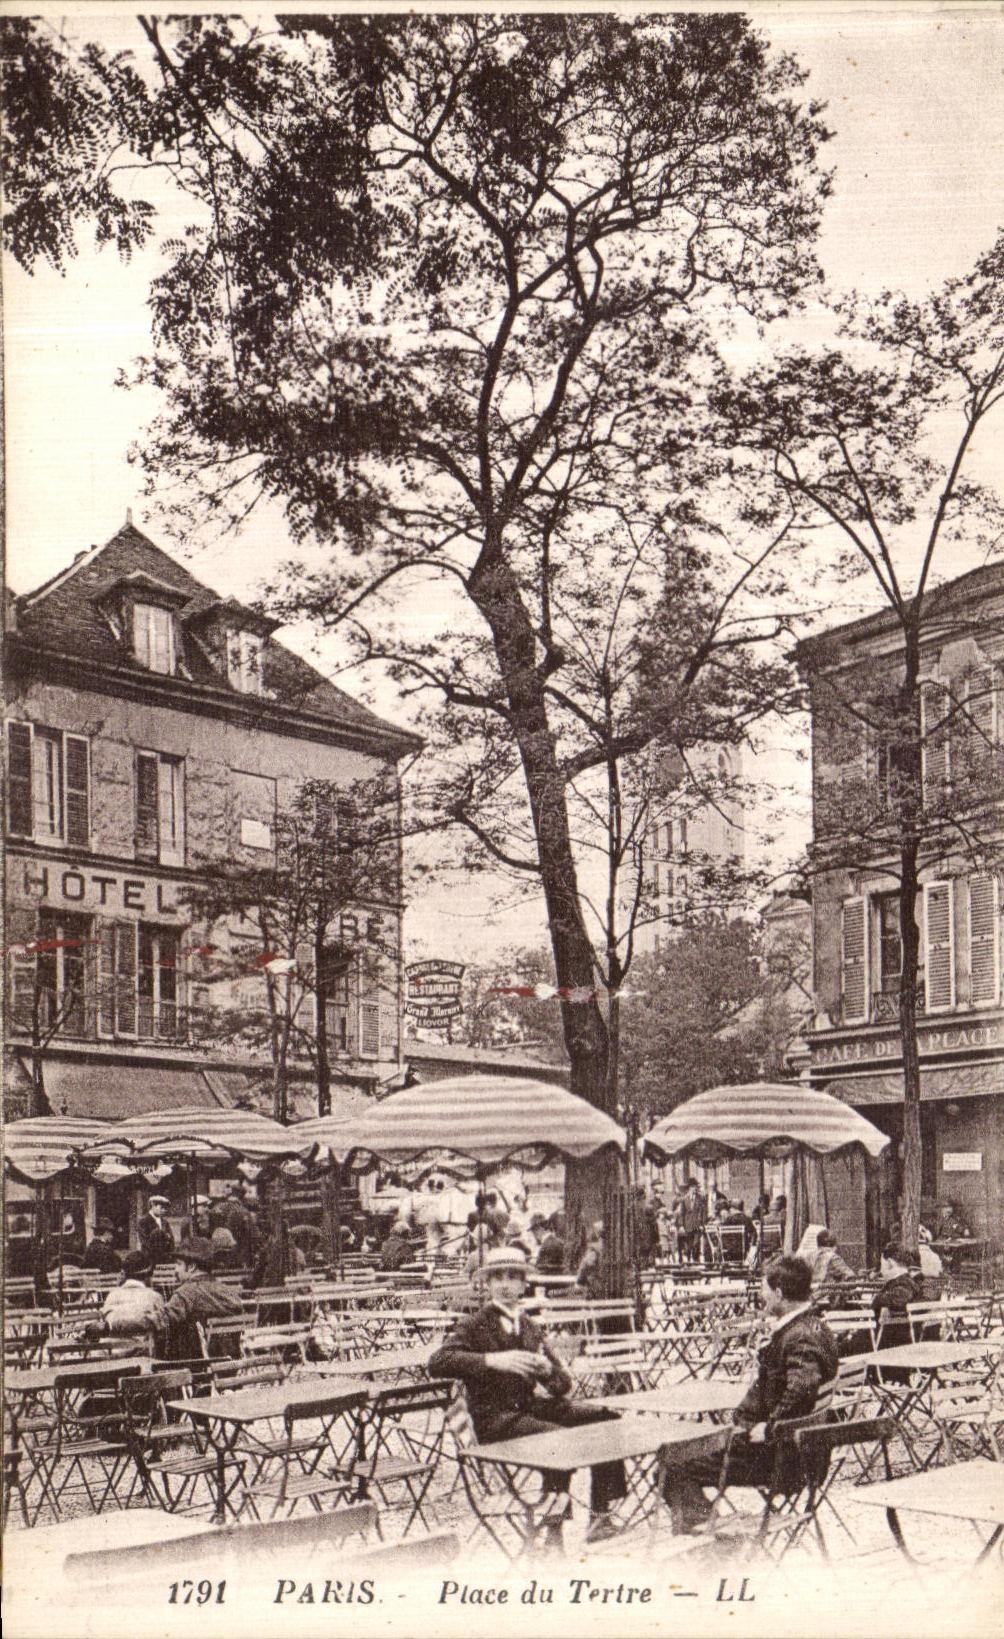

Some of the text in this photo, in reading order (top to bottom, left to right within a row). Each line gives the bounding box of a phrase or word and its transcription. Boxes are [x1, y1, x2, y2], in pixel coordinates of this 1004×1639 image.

[23, 864, 178, 915] HÔTEL
[875, 1041, 897, 1056] DE
[928, 1027, 999, 1048] PLACE
